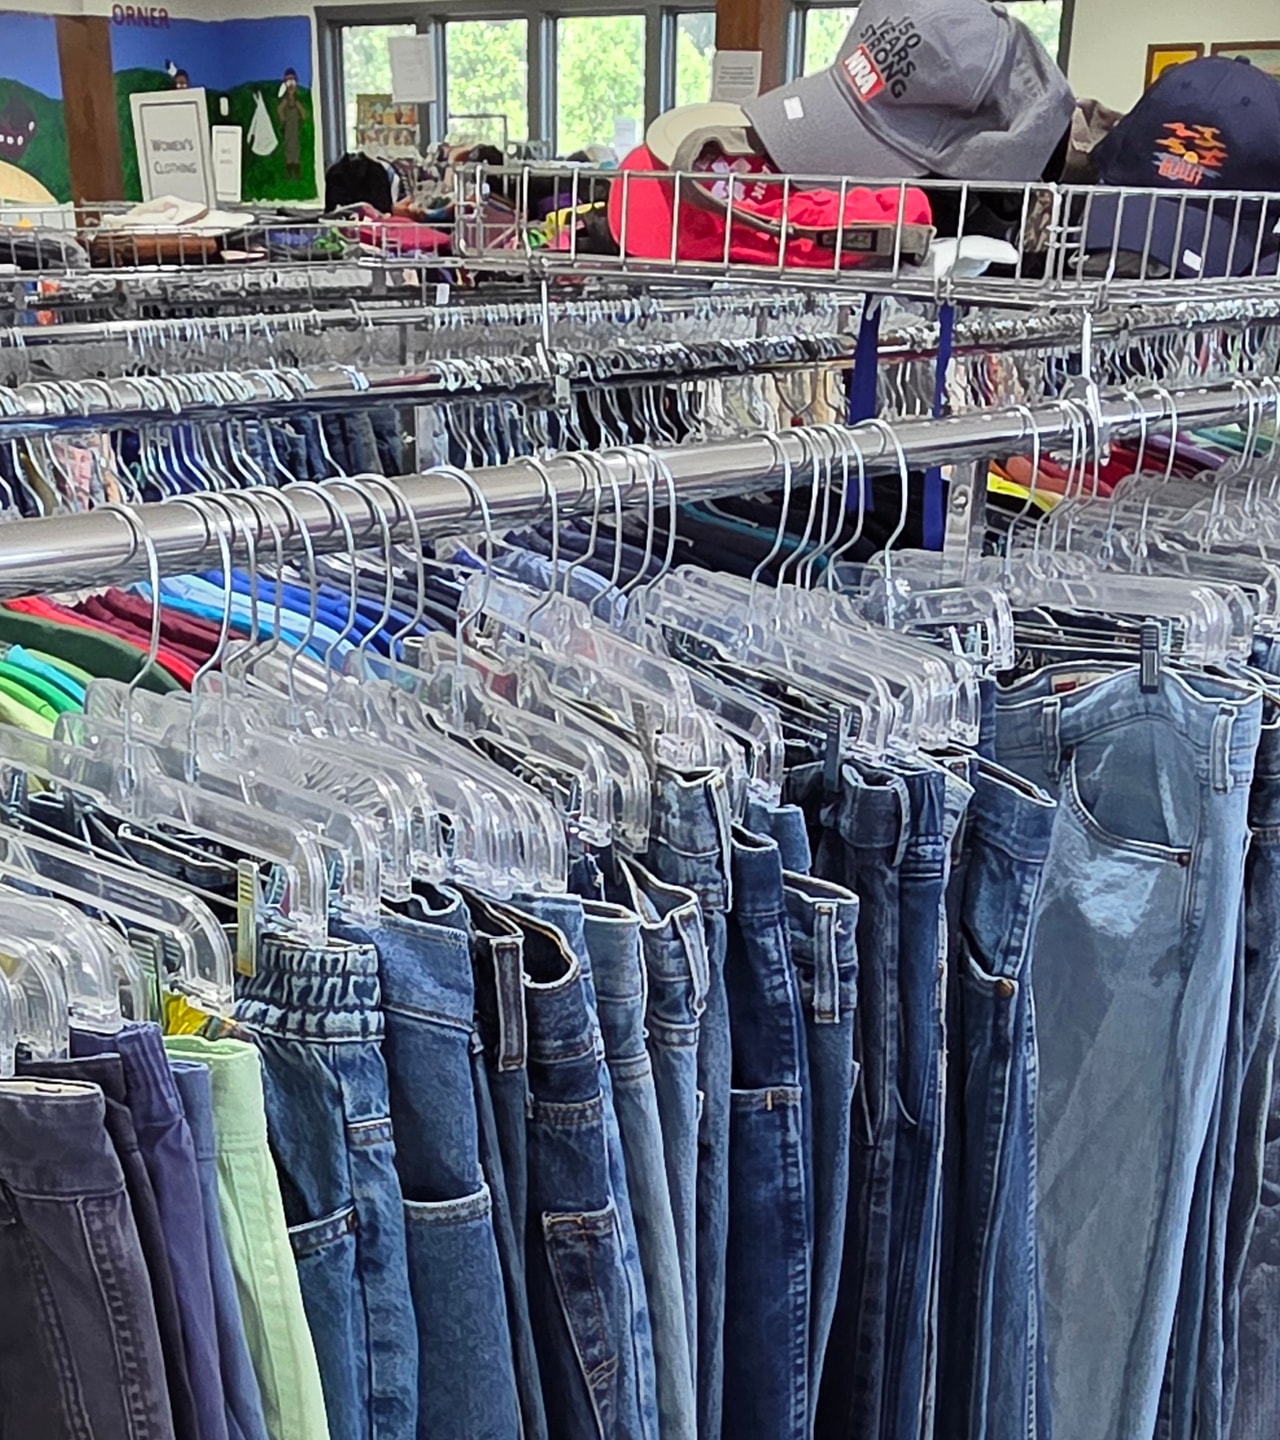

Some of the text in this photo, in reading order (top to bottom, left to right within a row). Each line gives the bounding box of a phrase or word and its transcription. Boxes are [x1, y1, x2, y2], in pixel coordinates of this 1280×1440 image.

[110, 4, 170, 28] ORNER
[894, 16, 922, 49] 150
[860, 24, 907, 99] STRONG
[876, 16, 917, 77] YEARS
[844, 49, 878, 95] NRA
